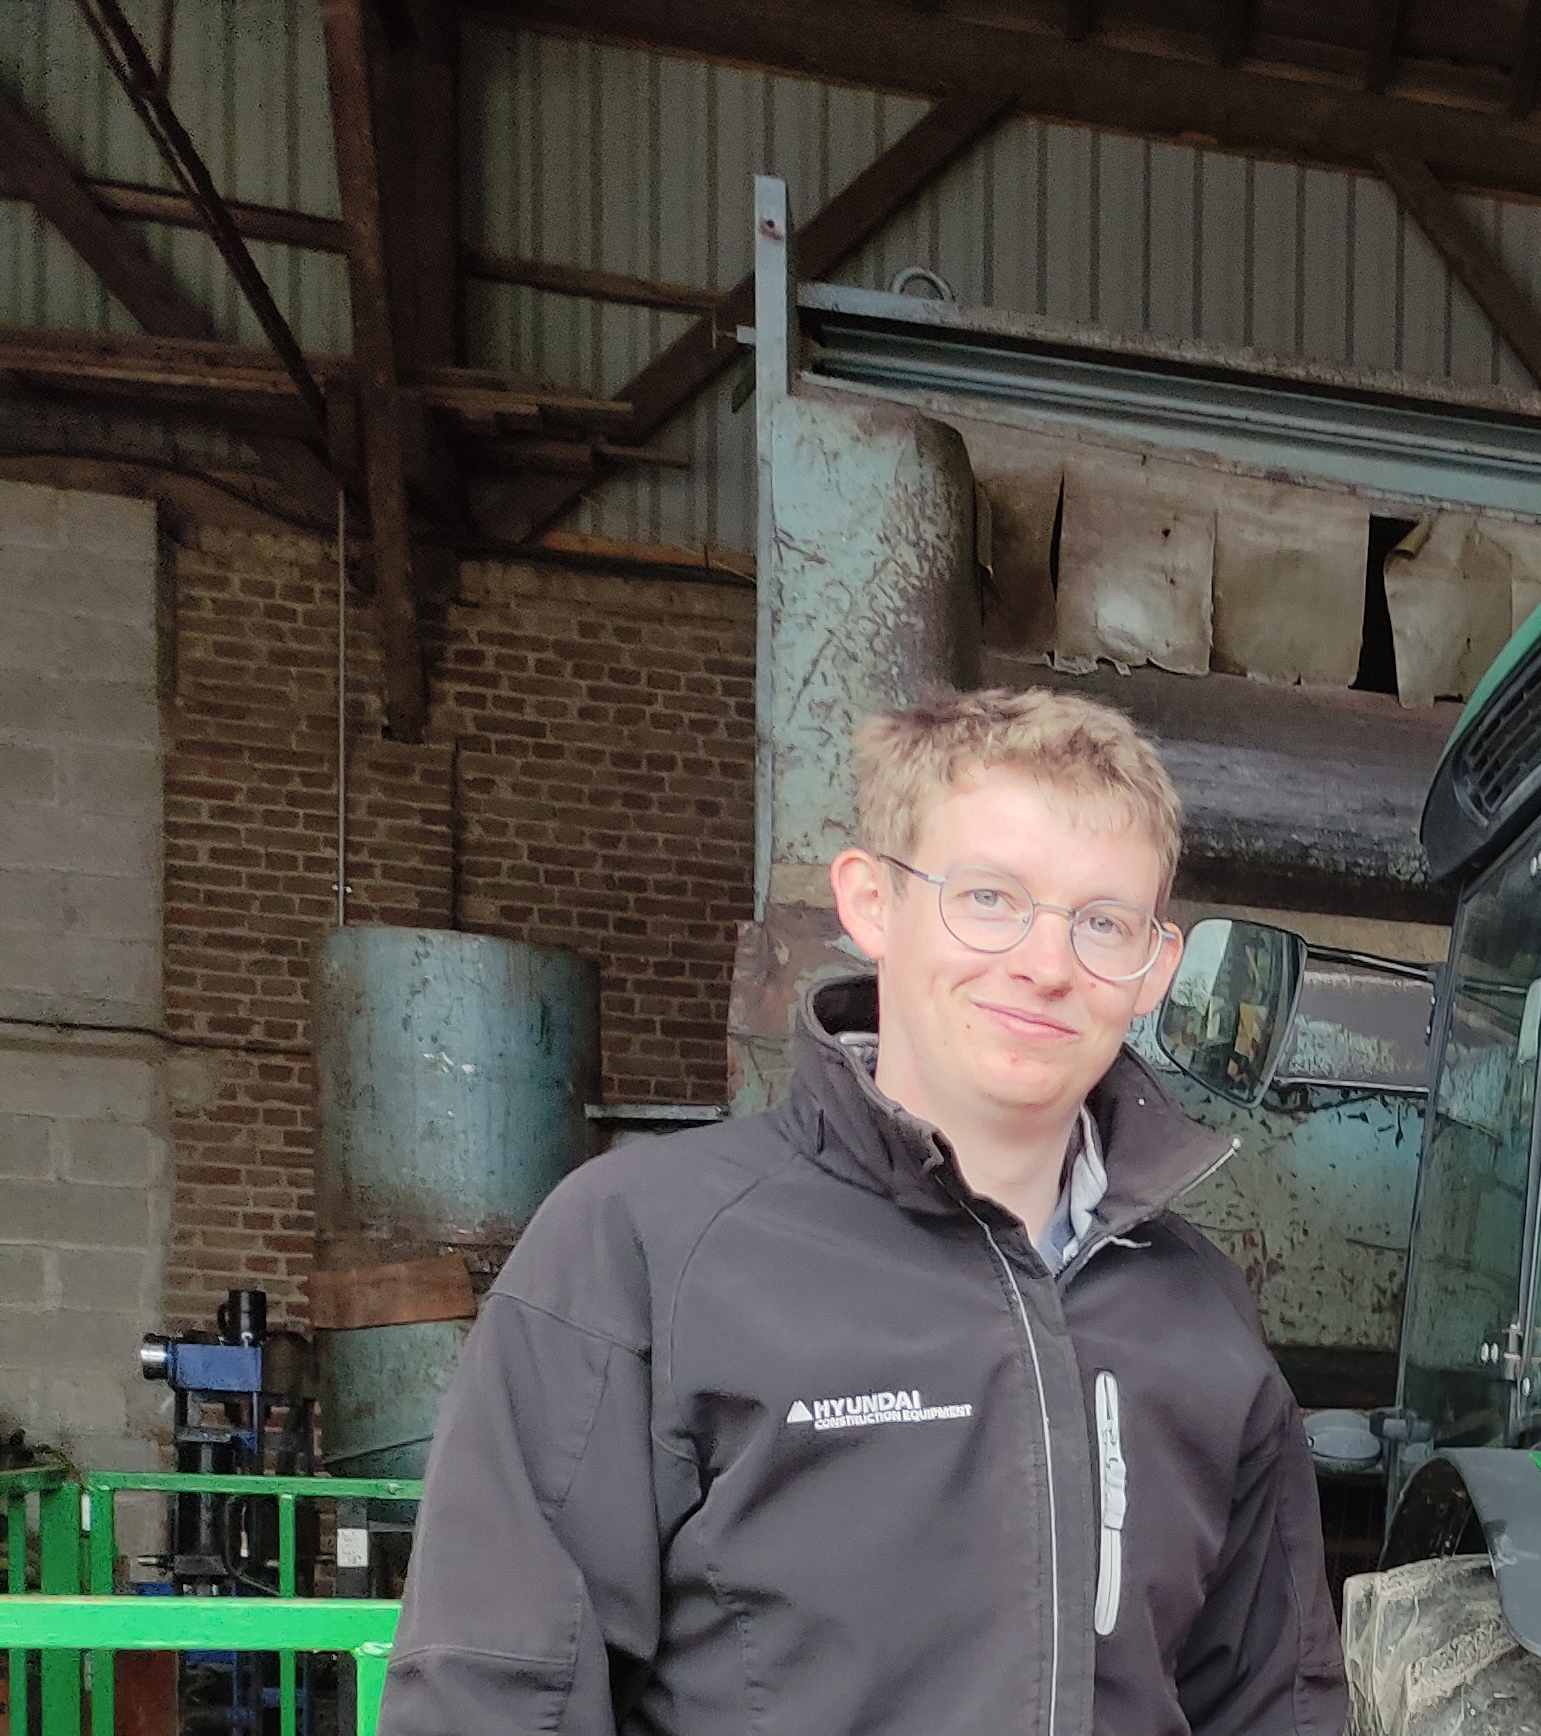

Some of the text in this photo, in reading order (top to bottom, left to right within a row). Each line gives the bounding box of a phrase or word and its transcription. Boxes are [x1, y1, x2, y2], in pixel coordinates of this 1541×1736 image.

[813, 1390, 922, 1420] HYUNDAI
[814, 1403, 973, 1431] CONSTRUCTION EQUIPMENT
